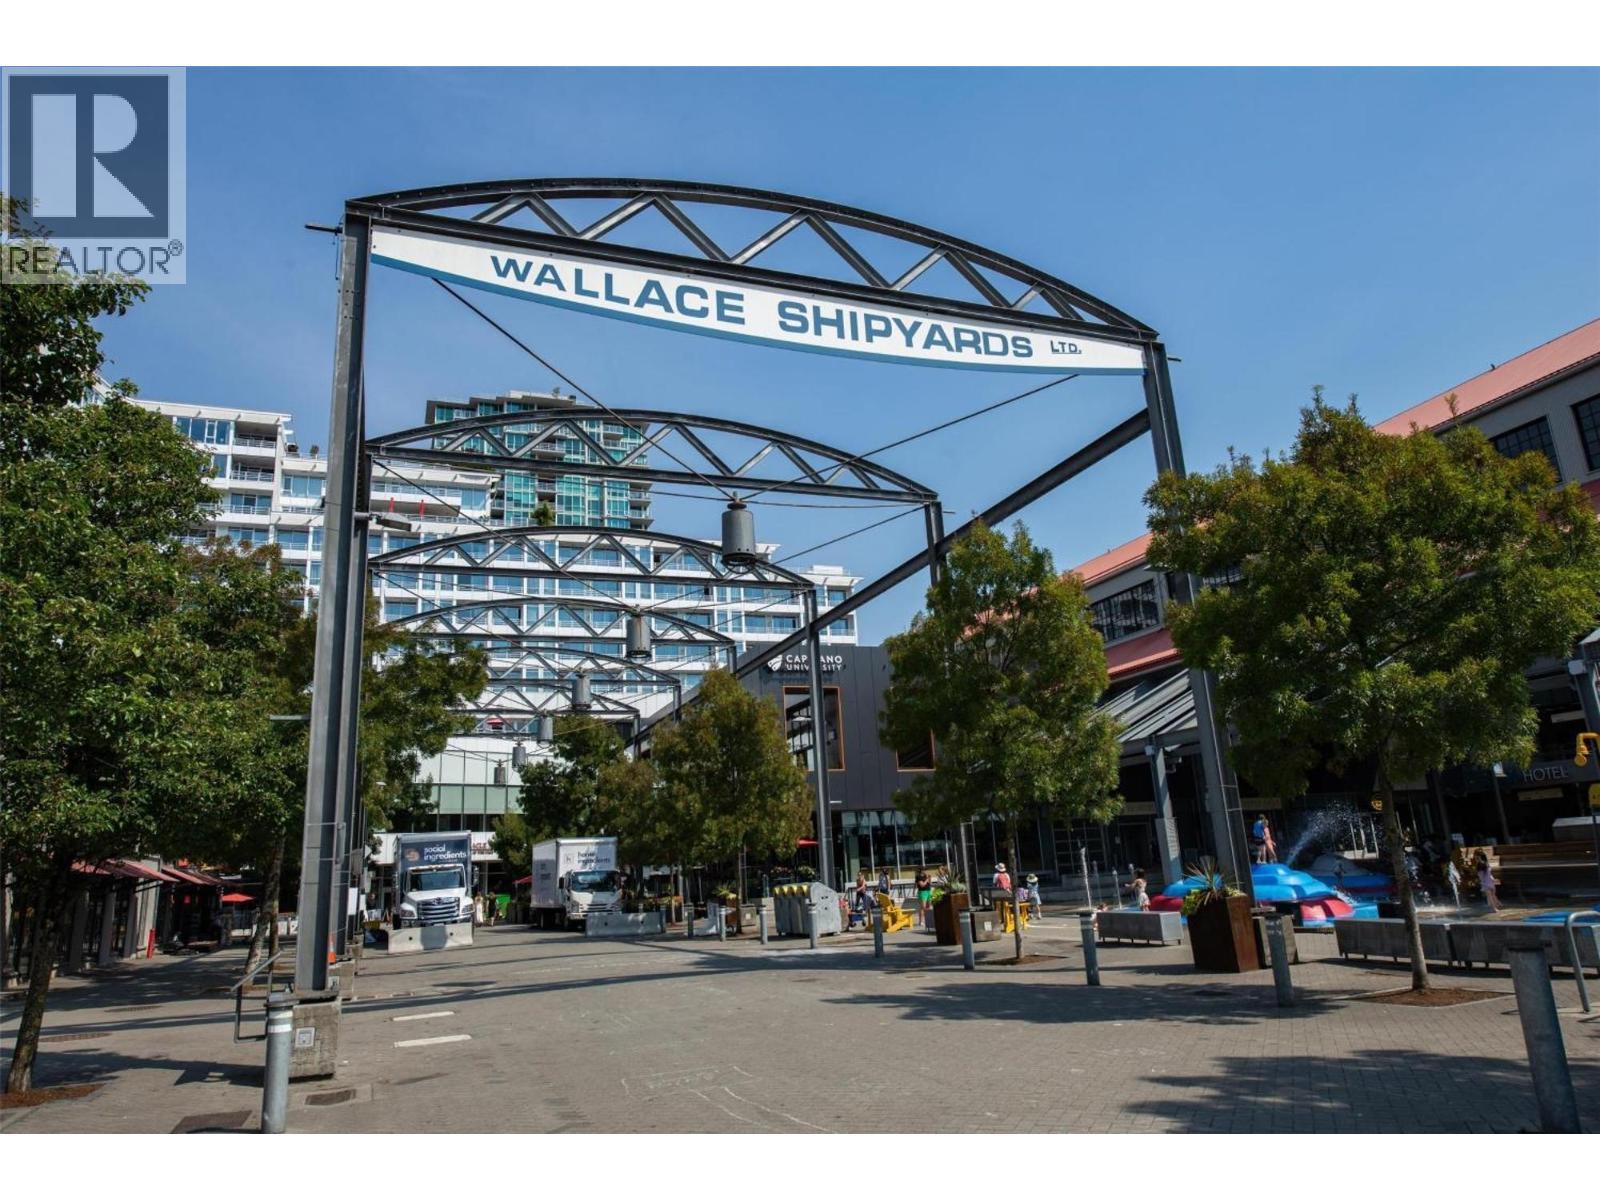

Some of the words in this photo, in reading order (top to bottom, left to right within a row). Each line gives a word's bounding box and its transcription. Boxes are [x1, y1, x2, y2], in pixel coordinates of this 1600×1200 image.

[490, 255, 746, 326] WALLACE
[777, 299, 1034, 358] SHIPYARDS
[1050, 340, 1082, 355] LTD.
[785, 654, 843, 664] CAPANO
[786, 663, 842, 671] UNIVSITY
[1522, 766, 1569, 781] HOTEL
[424, 843, 446, 853] social
[424, 851, 467, 862] ingredients
